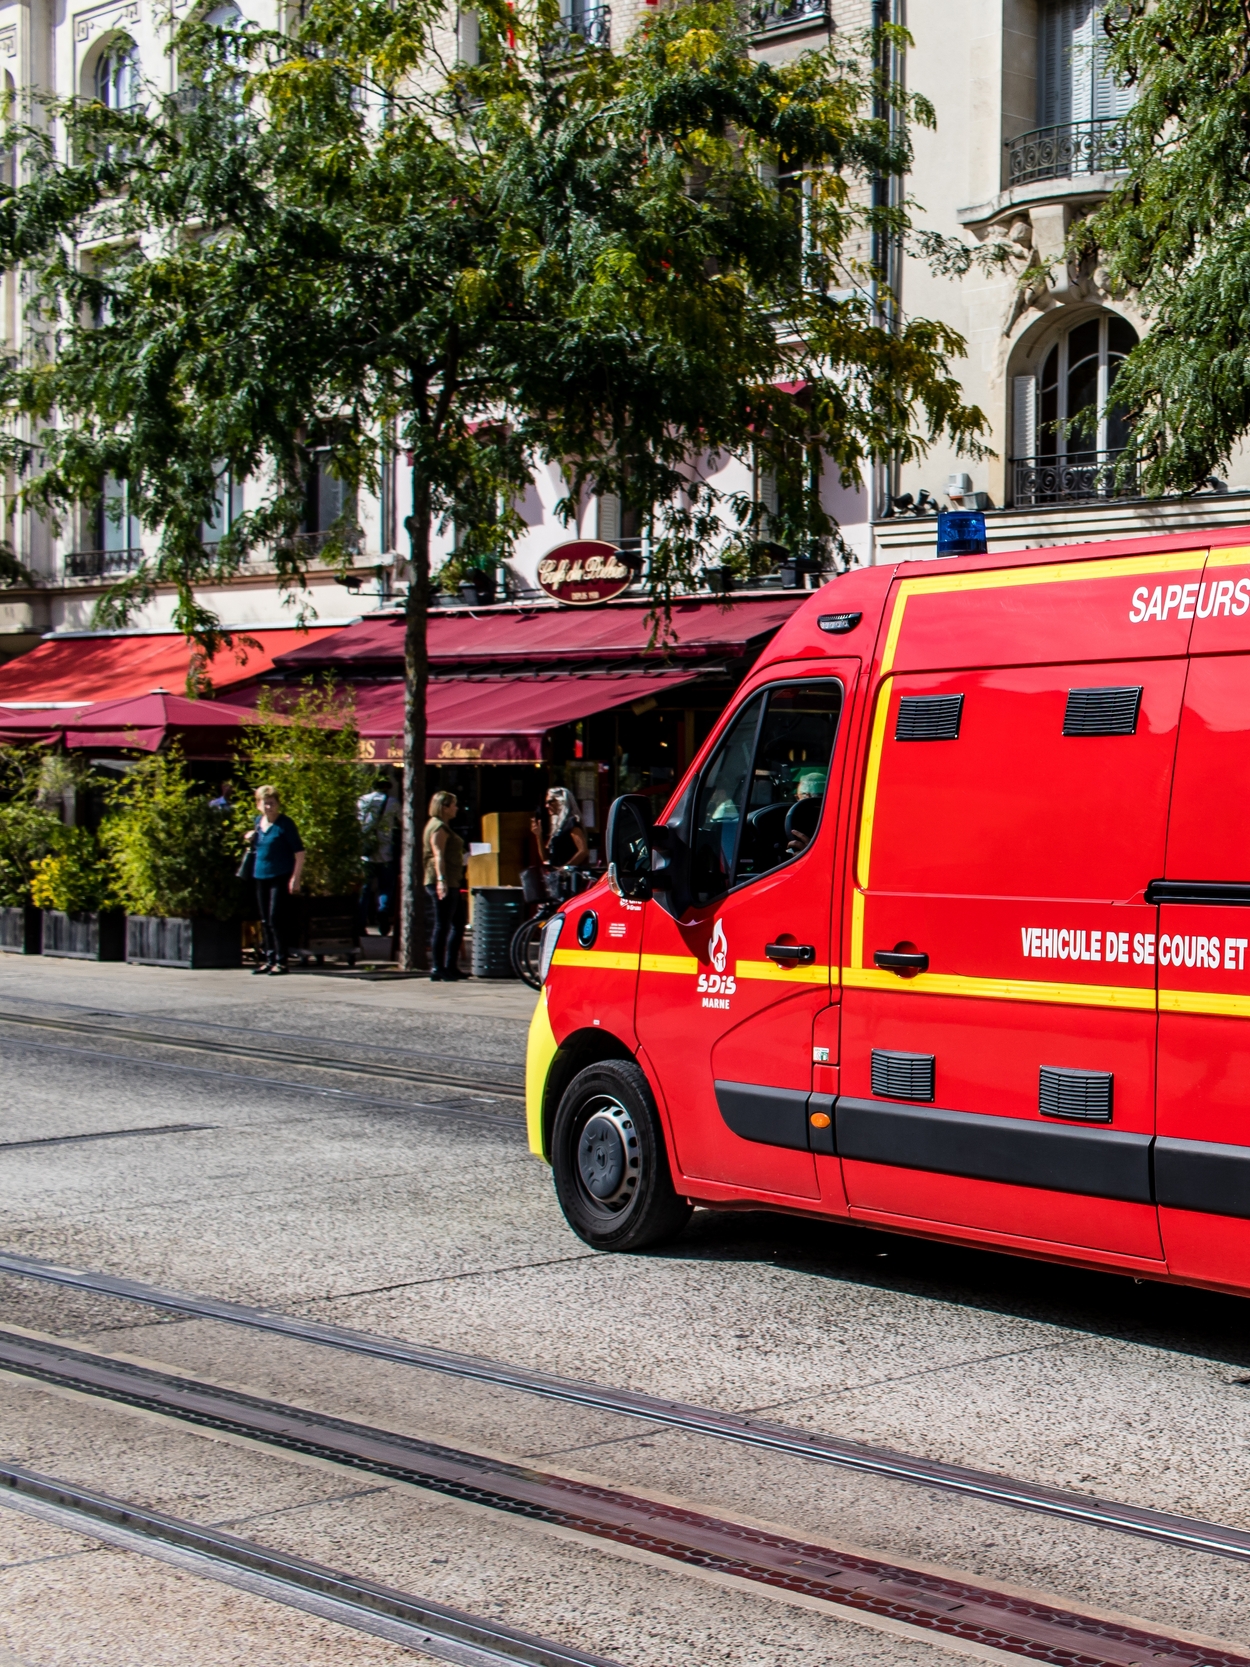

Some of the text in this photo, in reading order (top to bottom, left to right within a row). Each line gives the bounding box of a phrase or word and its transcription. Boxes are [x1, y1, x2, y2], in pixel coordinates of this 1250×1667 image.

[1021, 927, 1102, 961] VEHICULE
[1106, 931, 1130, 963] DE
[1224, 937, 1248, 970] ET
[702, 997, 730, 1010] MARNE
